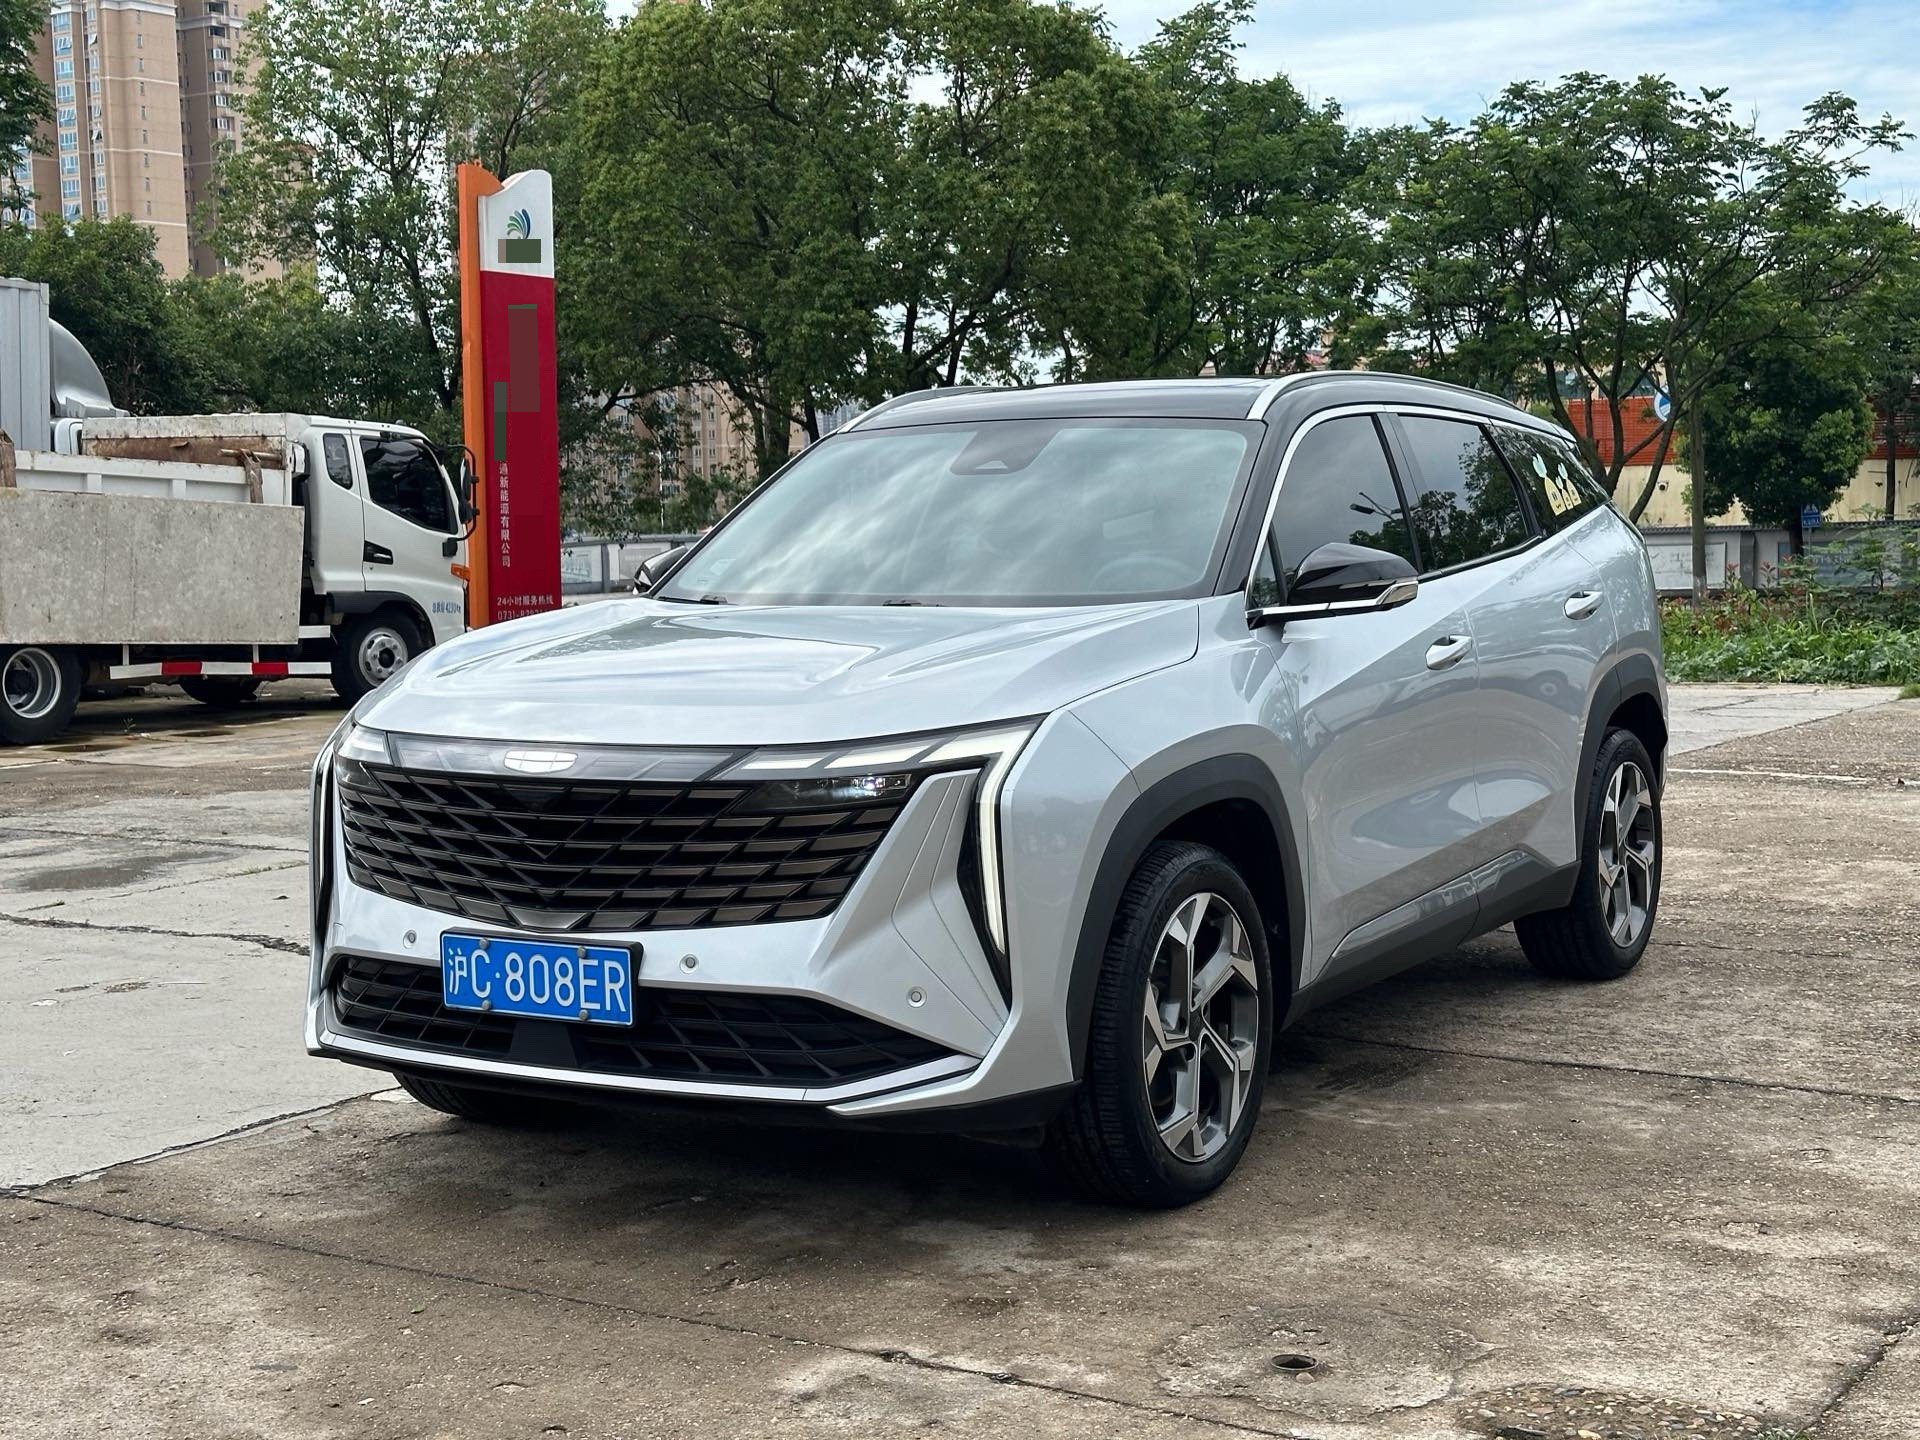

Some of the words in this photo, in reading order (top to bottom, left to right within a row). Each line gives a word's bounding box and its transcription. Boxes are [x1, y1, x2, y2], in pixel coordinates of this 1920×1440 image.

[496, 595, 554, 606] 24小时服务热线
